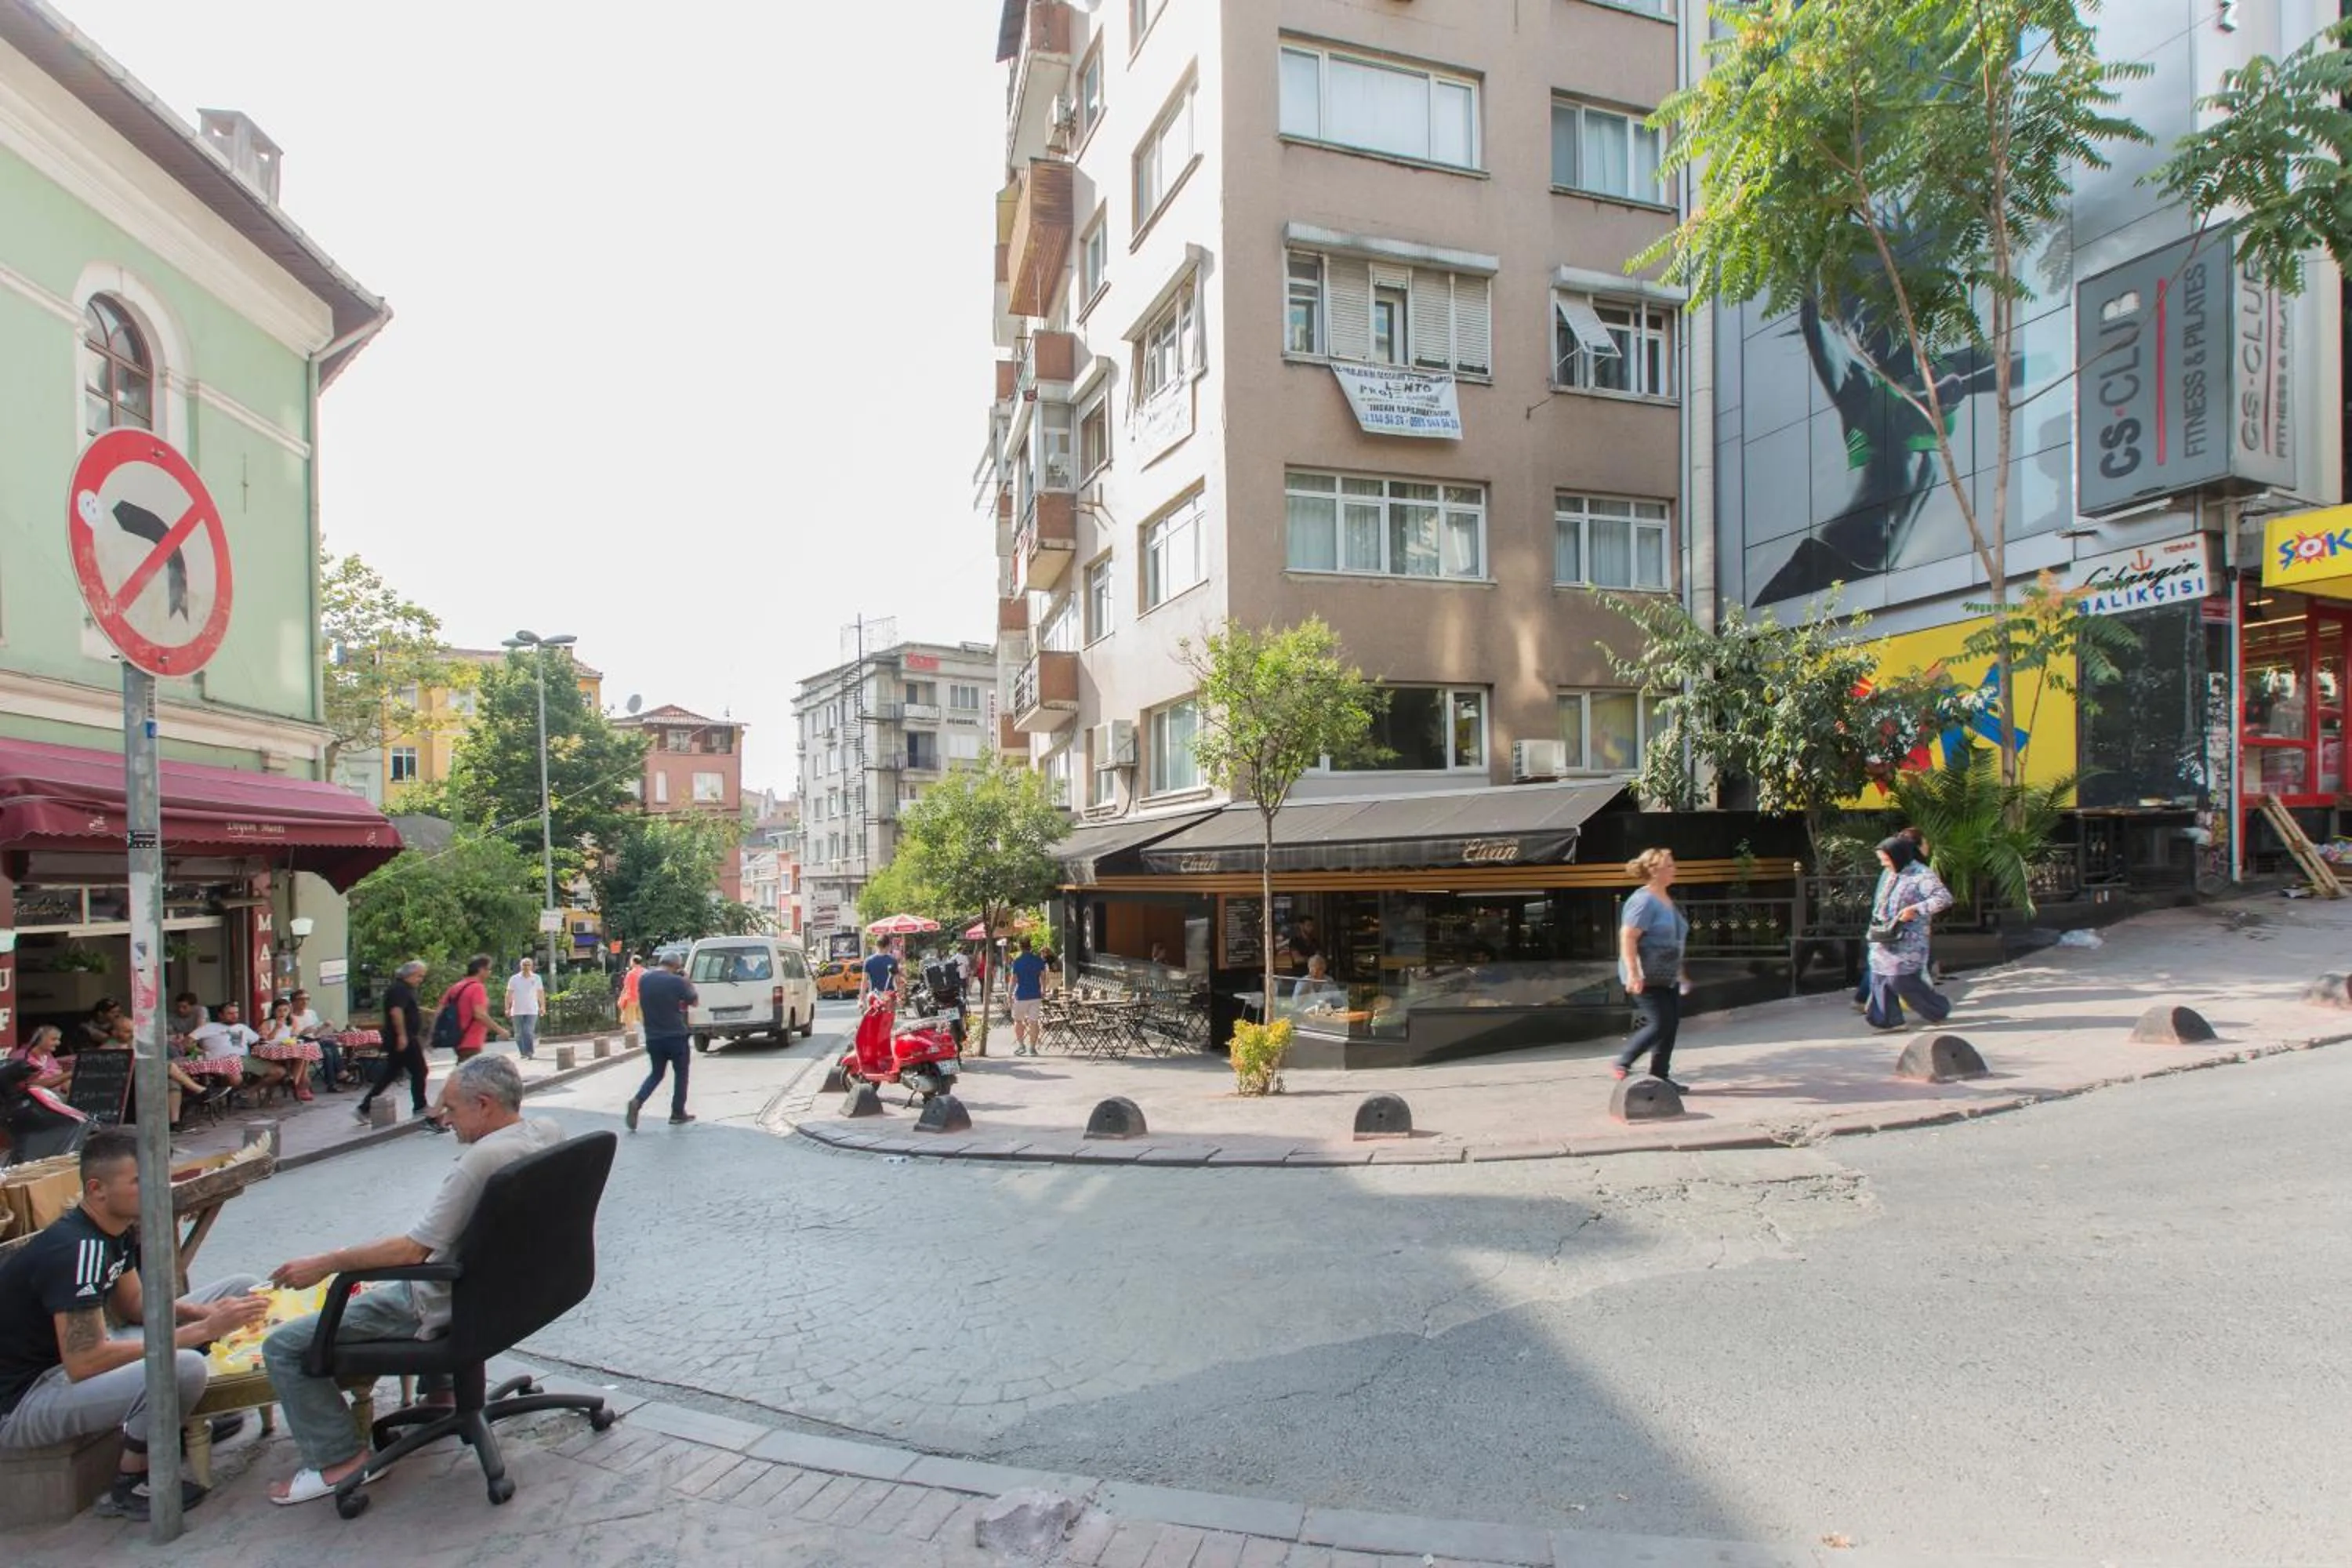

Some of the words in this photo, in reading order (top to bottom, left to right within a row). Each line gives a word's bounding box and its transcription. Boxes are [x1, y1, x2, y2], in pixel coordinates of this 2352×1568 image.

[2183, 262, 2207, 349] PILATES
[2277, 294, 2288, 350] PILAT
[2184, 350, 2206, 367] &
[2184, 368, 2208, 459] FITNESS
[2276, 375, 2288, 459] FITNESS
[2080, 577, 2204, 615] BALIKÇISI
